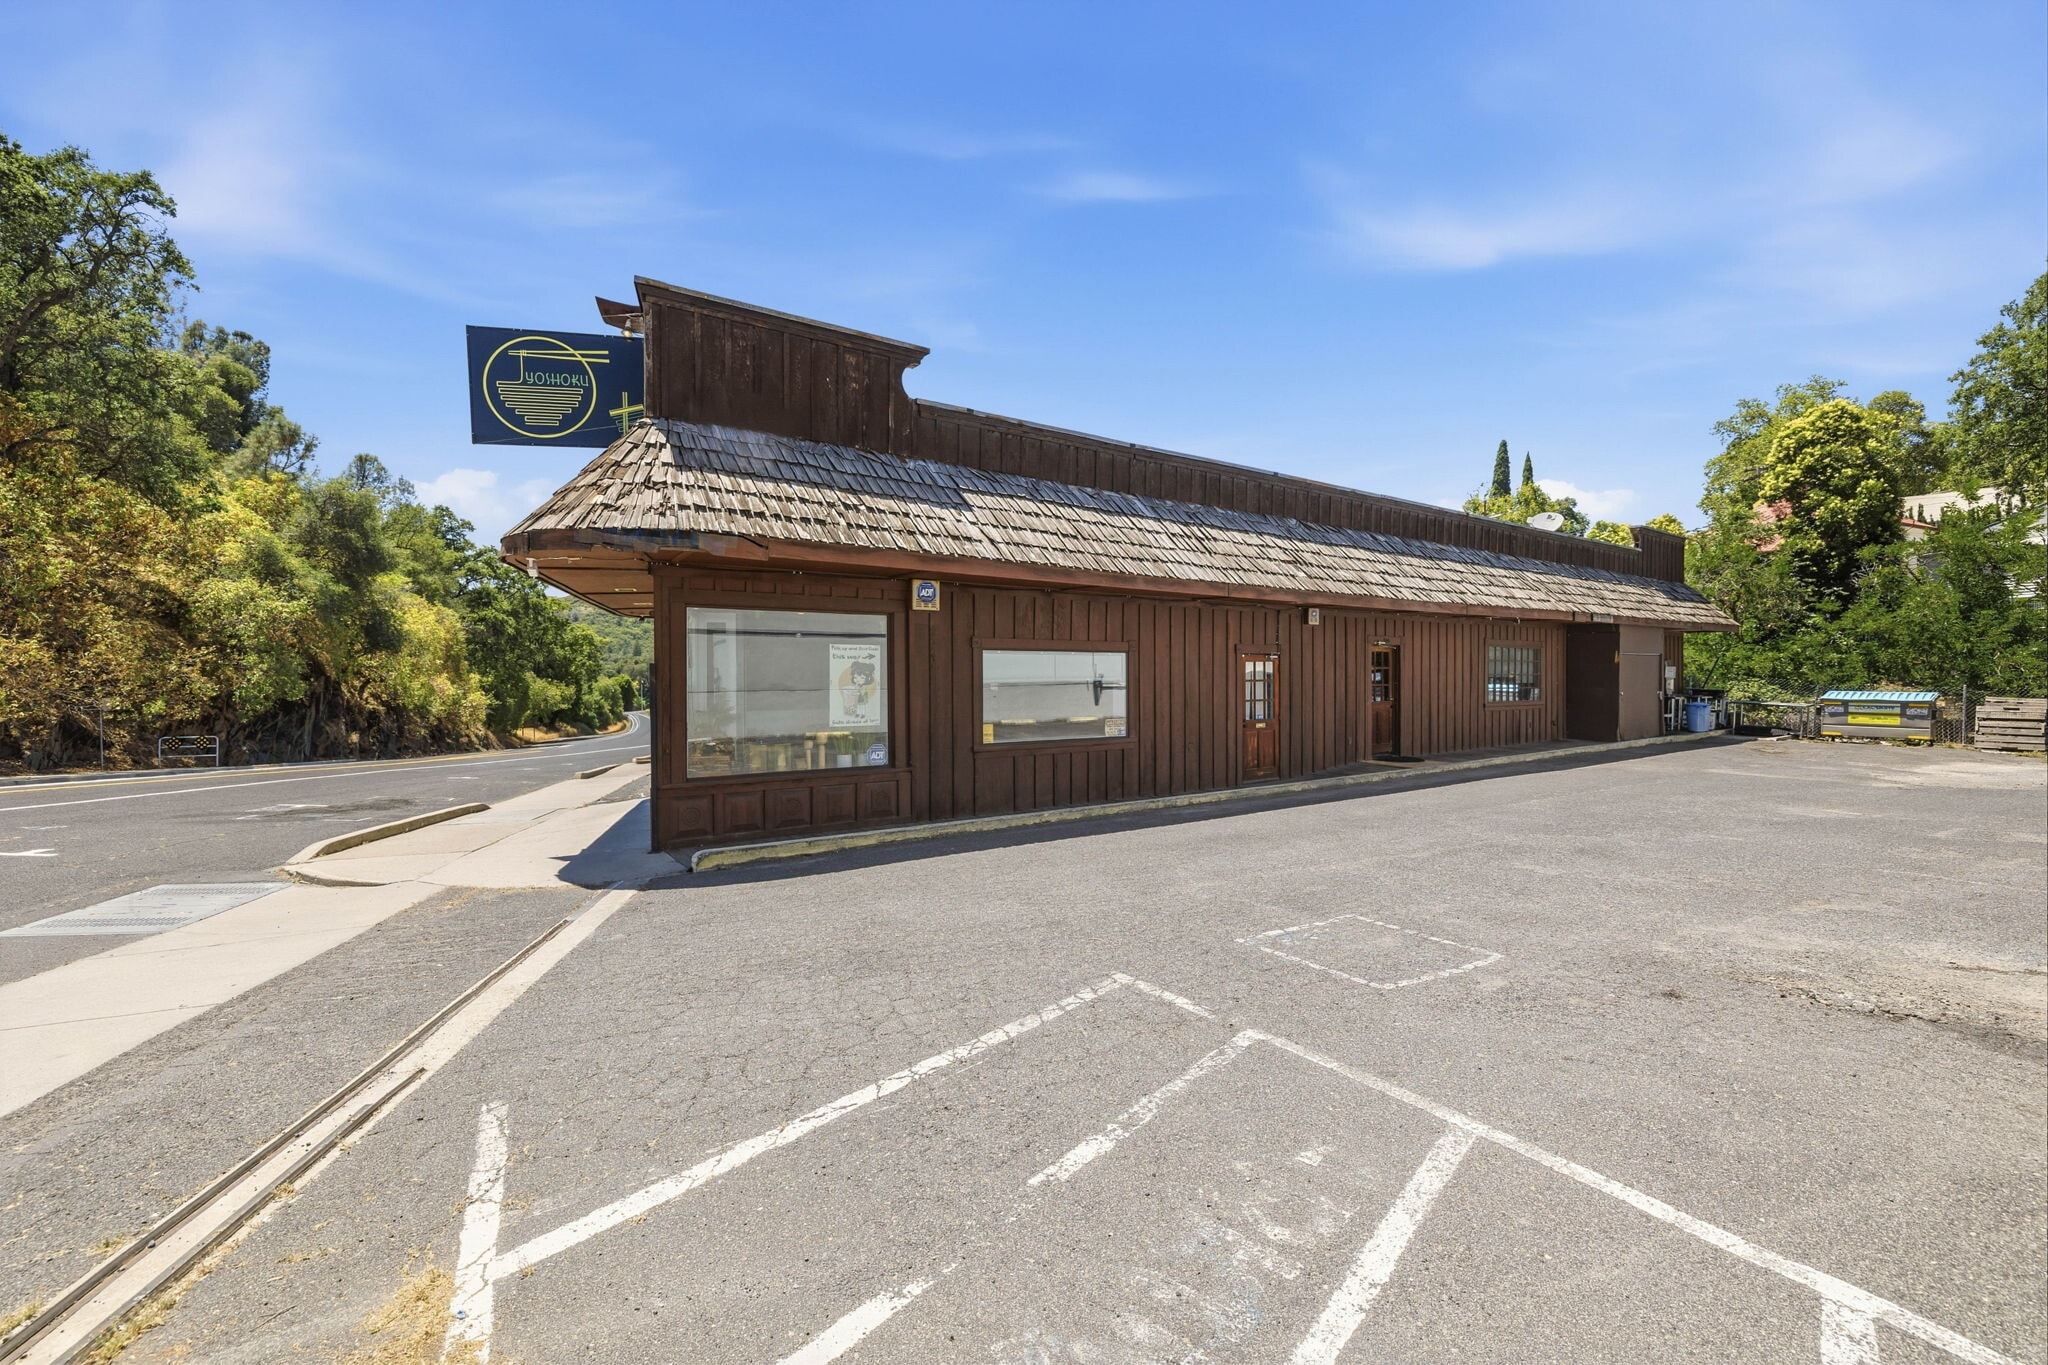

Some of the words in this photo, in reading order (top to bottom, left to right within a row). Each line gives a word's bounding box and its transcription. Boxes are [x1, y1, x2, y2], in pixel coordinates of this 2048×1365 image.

[525, 371, 589, 387] YOSHOKU
[920, 588, 934, 597] ADT
[870, 750, 886, 760] ADT
